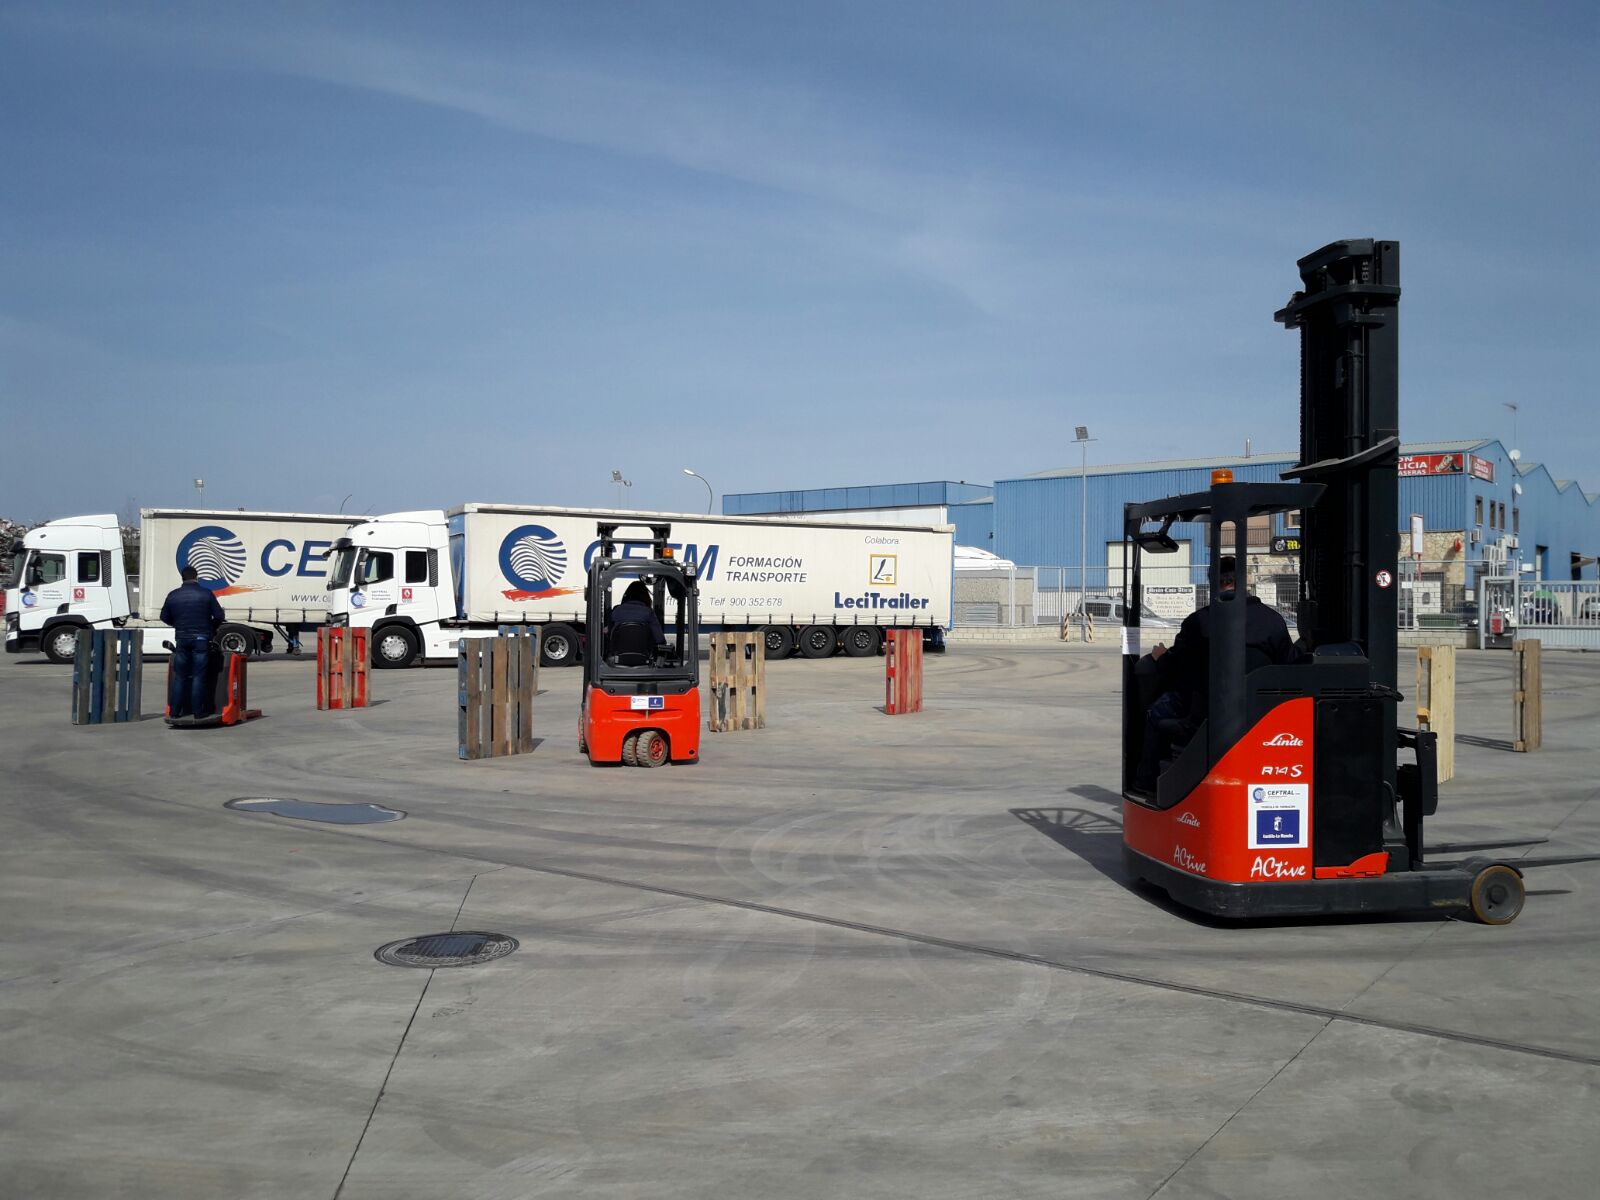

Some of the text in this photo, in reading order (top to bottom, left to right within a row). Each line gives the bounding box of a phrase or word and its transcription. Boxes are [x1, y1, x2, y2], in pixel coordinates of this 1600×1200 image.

[1398, 461, 1428, 470] LICIA
[261, 538, 333, 577] CE
[728, 555, 803, 569] FORMACIÓN
[726, 571, 808, 583] TRANSPORTE
[729, 597, 747, 607] 900
[748, 597, 765, 607] 352
[766, 597, 783, 607] 678
[834, 591, 930, 609] LeciTrailer
[1262, 732, 1304, 747] Linde
[1177, 811, 1201, 828] Linde
